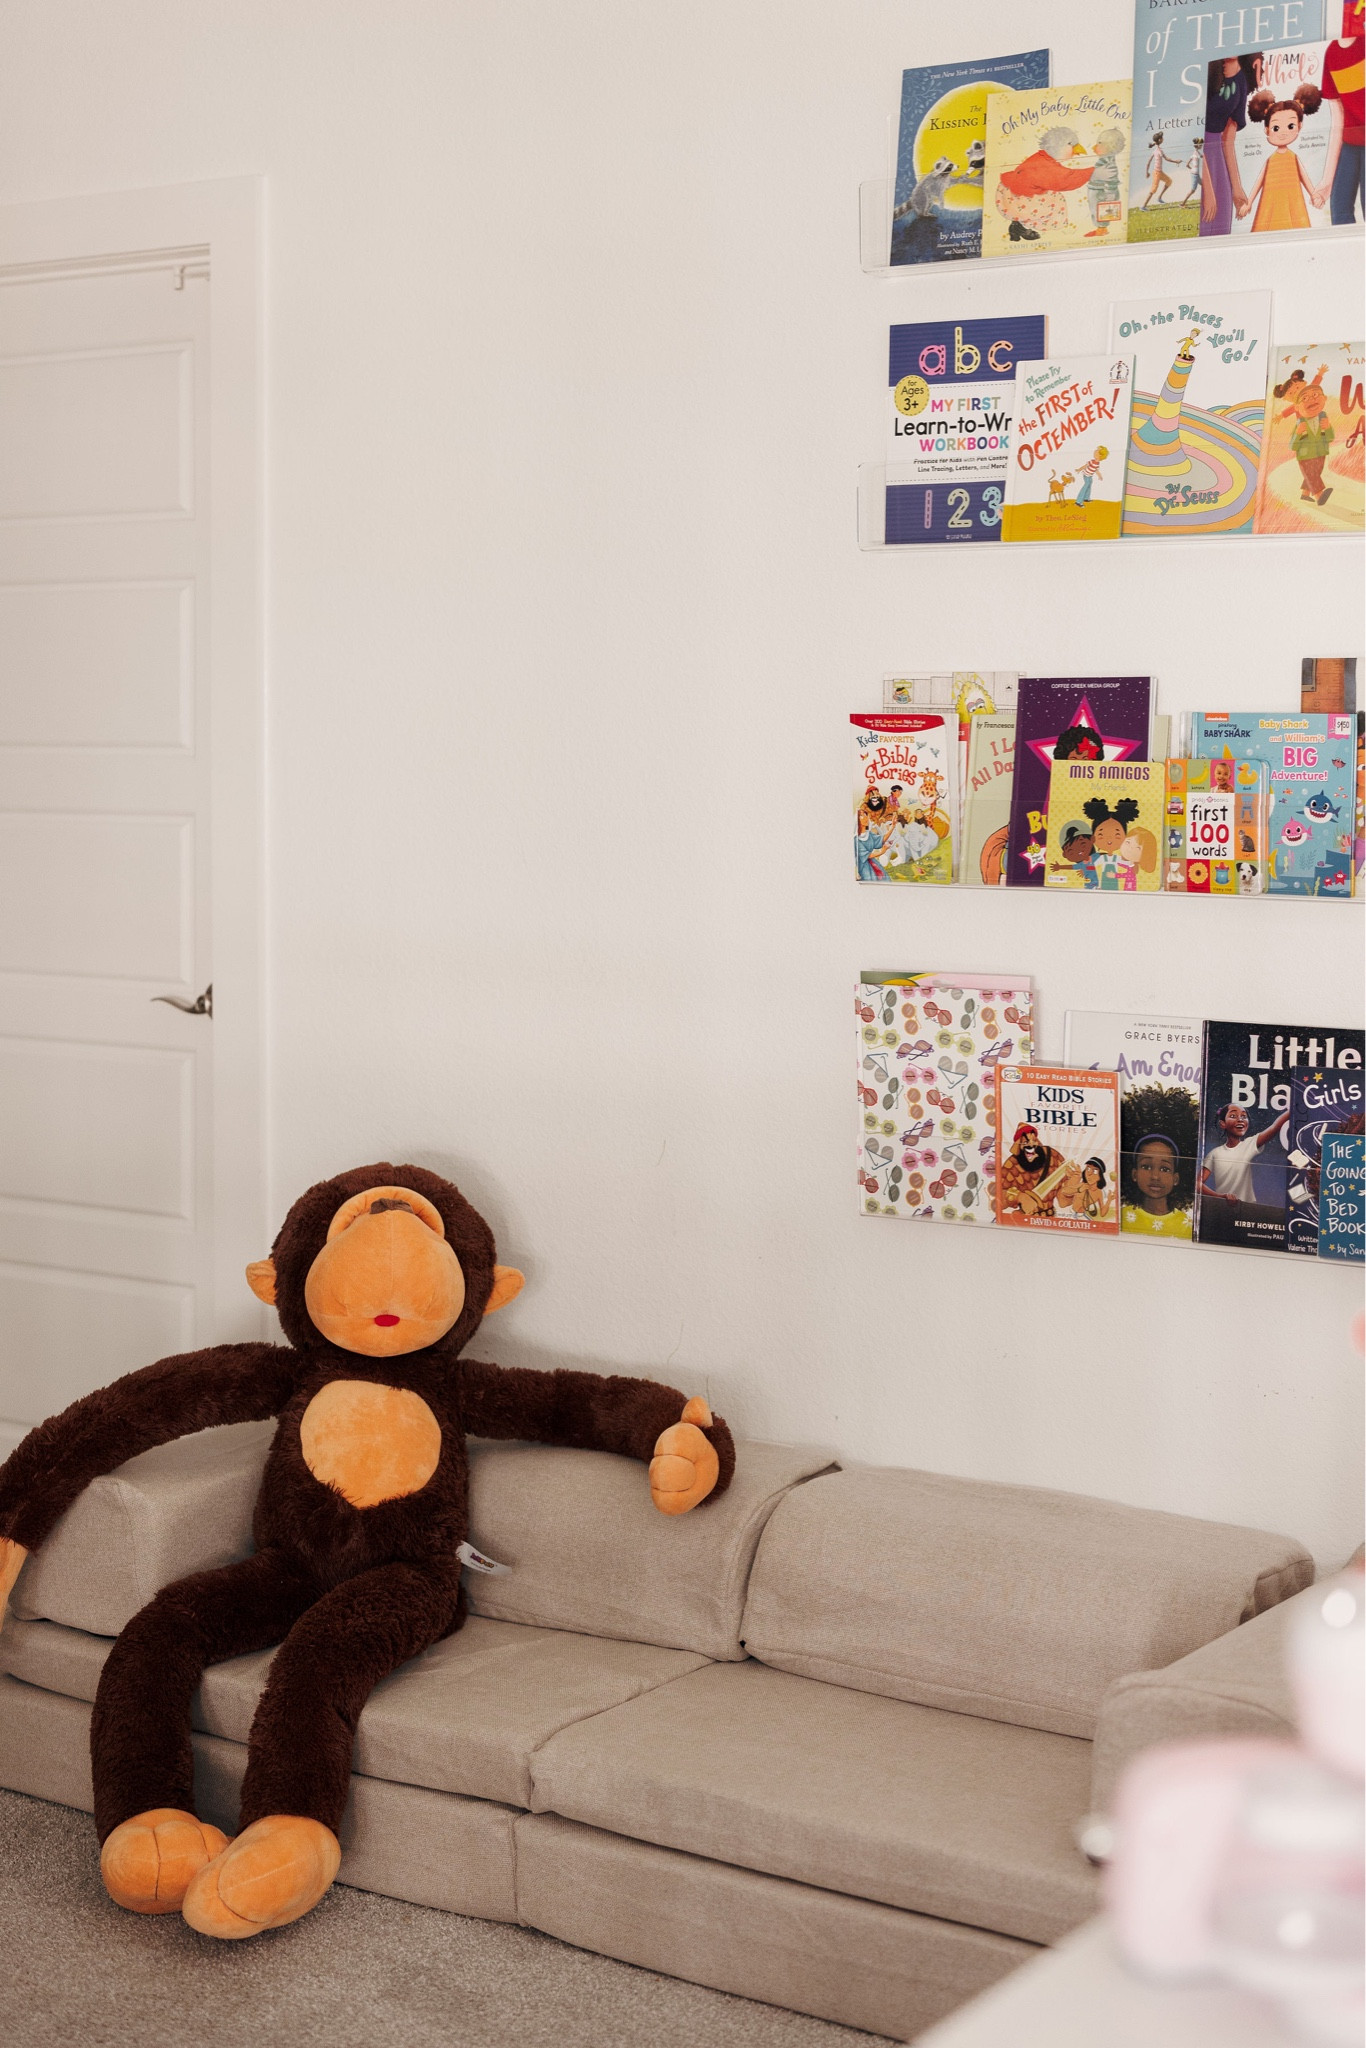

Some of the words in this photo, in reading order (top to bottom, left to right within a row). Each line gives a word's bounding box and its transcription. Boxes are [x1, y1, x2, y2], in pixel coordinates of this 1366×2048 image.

[1146, 18, 1177, 64] of
[1186, 1, 1304, 51] THEE
[1269, 54, 1274, 65] I
[1282, 53, 1299, 65] AM
[1252, 52, 1319, 87] Whole
[1145, 70, 1158, 108] I
[969, 105, 982, 113] The
[1001, 115, 1019, 135] Oh
[1020, 108, 1039, 126] My
[1075, 95, 1106, 113] Little
[1106, 103, 1131, 120] One
[930, 117, 979, 131] KISSING
[1146, 120, 1154, 131] A
[1158, 117, 1194, 130] Letter
[939, 231, 949, 242] by
[950, 229, 977, 240] Audrey
[1150, 312, 1174, 325] the
[1178, 305, 1223, 329] Places
[1206, 329, 1245, 348] You'll
[1221, 339, 1258, 364] Go!
[907, 380, 917, 388] for
[1026, 372, 1049, 389] Please
[1049, 366, 1061, 376] Try
[900, 386, 925, 399] Ages
[1025, 395, 1034, 404] to
[1034, 374, 1072, 398] Remember
[903, 398, 919, 411] 3+
[931, 399, 954, 412] MY
[958, 396, 1001, 411] FIRST
[1018, 418, 1038, 436] the
[1035, 383, 1081, 427] FIRST
[1081, 380, 1093, 396] of
[919, 435, 1009, 452] WORKBOOK
[1153, 496, 1180, 516] Dr.
[1181, 485, 1220, 507] Seuss
[976, 721, 984, 730] by
[1203, 729, 1224, 738] BABY
[1224, 728, 1252, 738] SHARK
[1259, 720, 1280, 731] Baby
[1282, 719, 1309, 729] Shark
[856, 731, 879, 748] Kids
[879, 735, 915, 744] FAVORITE
[1284, 733, 1325, 743] William's
[876, 745, 918, 767] Bible
[1283, 747, 1318, 767] BIG
[865, 759, 917, 786] Stories
[971, 767, 992, 792] All
[1069, 765, 1095, 779] MIS
[1099, 765, 1150, 781] AMIGOS
[1270, 770, 1328, 781] Adventure!
[1190, 804, 1228, 821] first
[1189, 821, 1230, 844] 100
[1192, 844, 1228, 857] words
[1125, 1031, 1162, 1042] GRACE
[1167, 1034, 1200, 1045] BYERS
[1248, 1034, 1362, 1071] Little
[1113, 1052, 1153, 1080] Am
[1051, 1073, 1067, 1081] READ
[1068, 1075, 1086, 1083] BIBLE
[1087, 1076, 1112, 1085] STORIES
[1037, 1085, 1084, 1104] KIDS
[1303, 1079, 1362, 1109] Girls
[1024, 1107, 1097, 1127] BIBLE
[1035, 1125, 1087, 1135] STORIES
[1328, 1140, 1355, 1159] THE
[1328, 1182, 1345, 1196] TO
[1326, 1198, 1358, 1217] BED
[1029, 1217, 1052, 1227] DAVID
[1058, 1219, 1090, 1230] GOLIATH
[1234, 1220, 1256, 1229] KIRBY
[1325, 1217, 1365, 1235] BOOK
[1337, 1243, 1347, 1257] by
